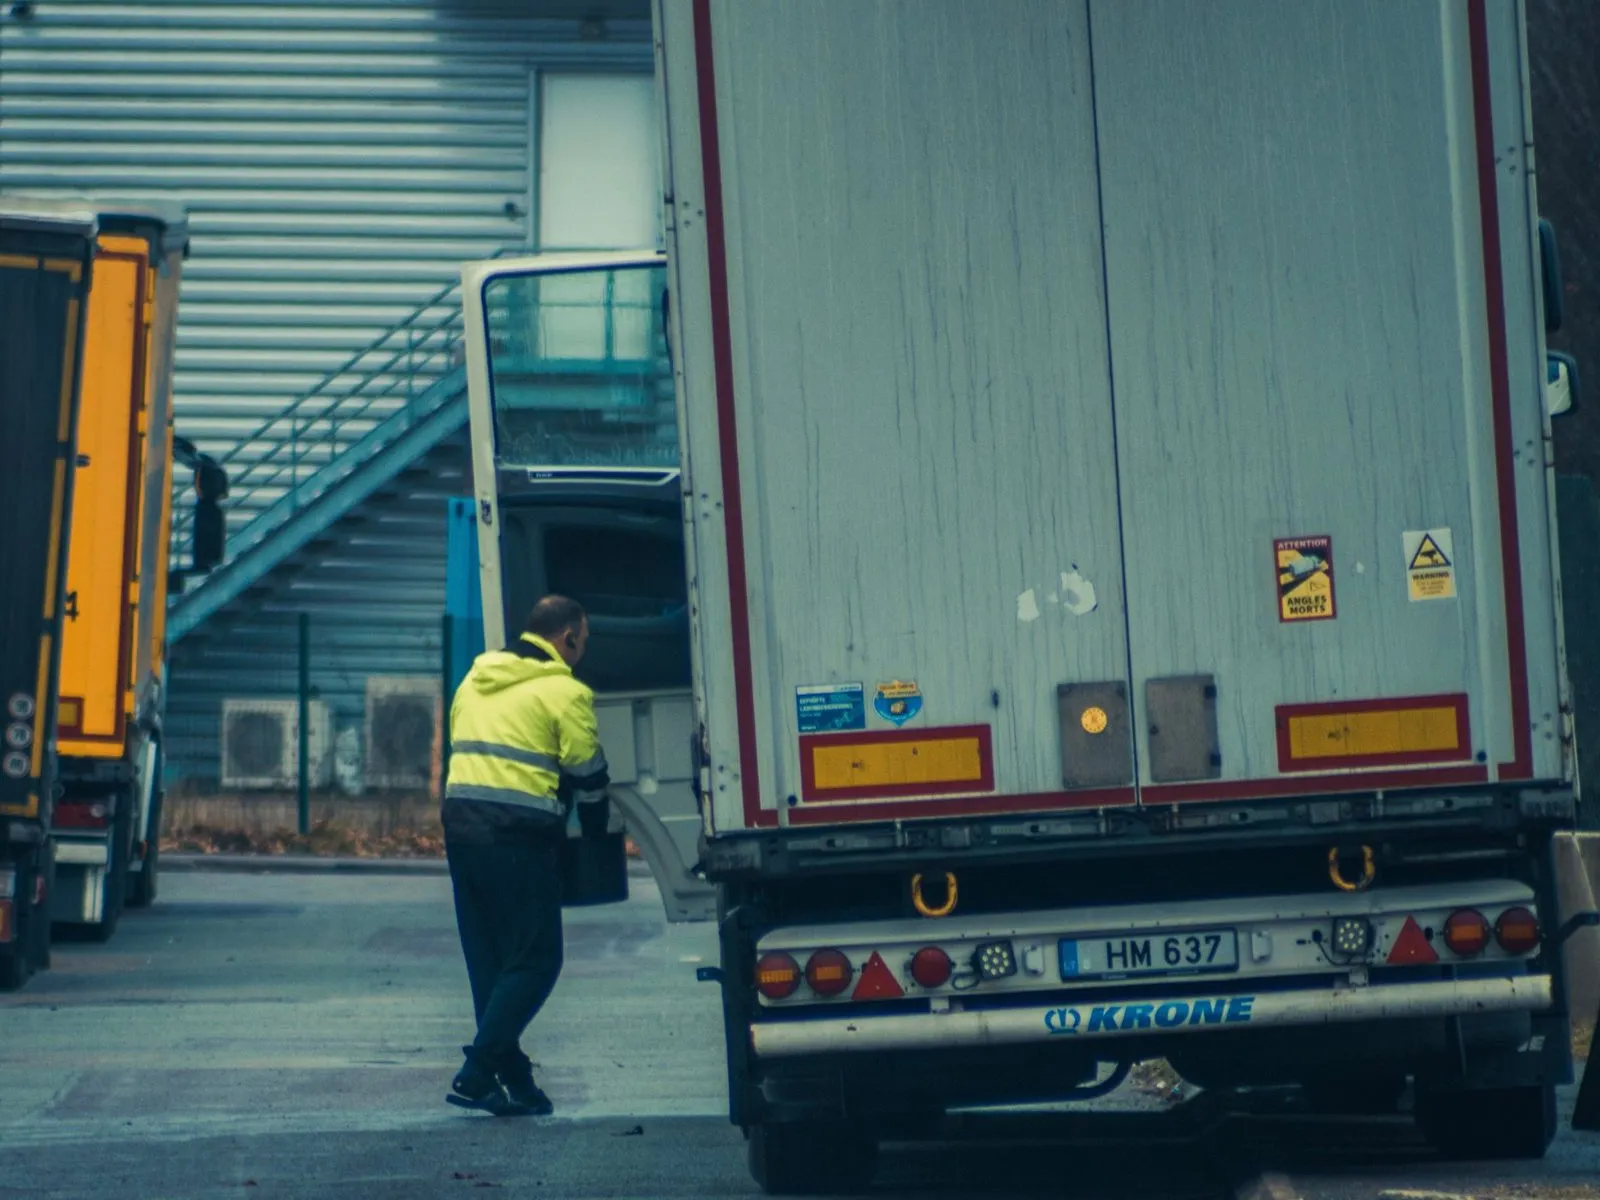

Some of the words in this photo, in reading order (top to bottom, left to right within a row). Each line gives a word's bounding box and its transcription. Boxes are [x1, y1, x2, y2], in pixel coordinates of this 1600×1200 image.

[1278, 538, 1328, 549] ATTENTION
[1287, 595, 1327, 606] ANGLES
[1289, 604, 1326, 614] MORTS
[1106, 940, 1151, 969] HM
[1163, 935, 1222, 965] 637
[1087, 997, 1255, 1032] KRONE
